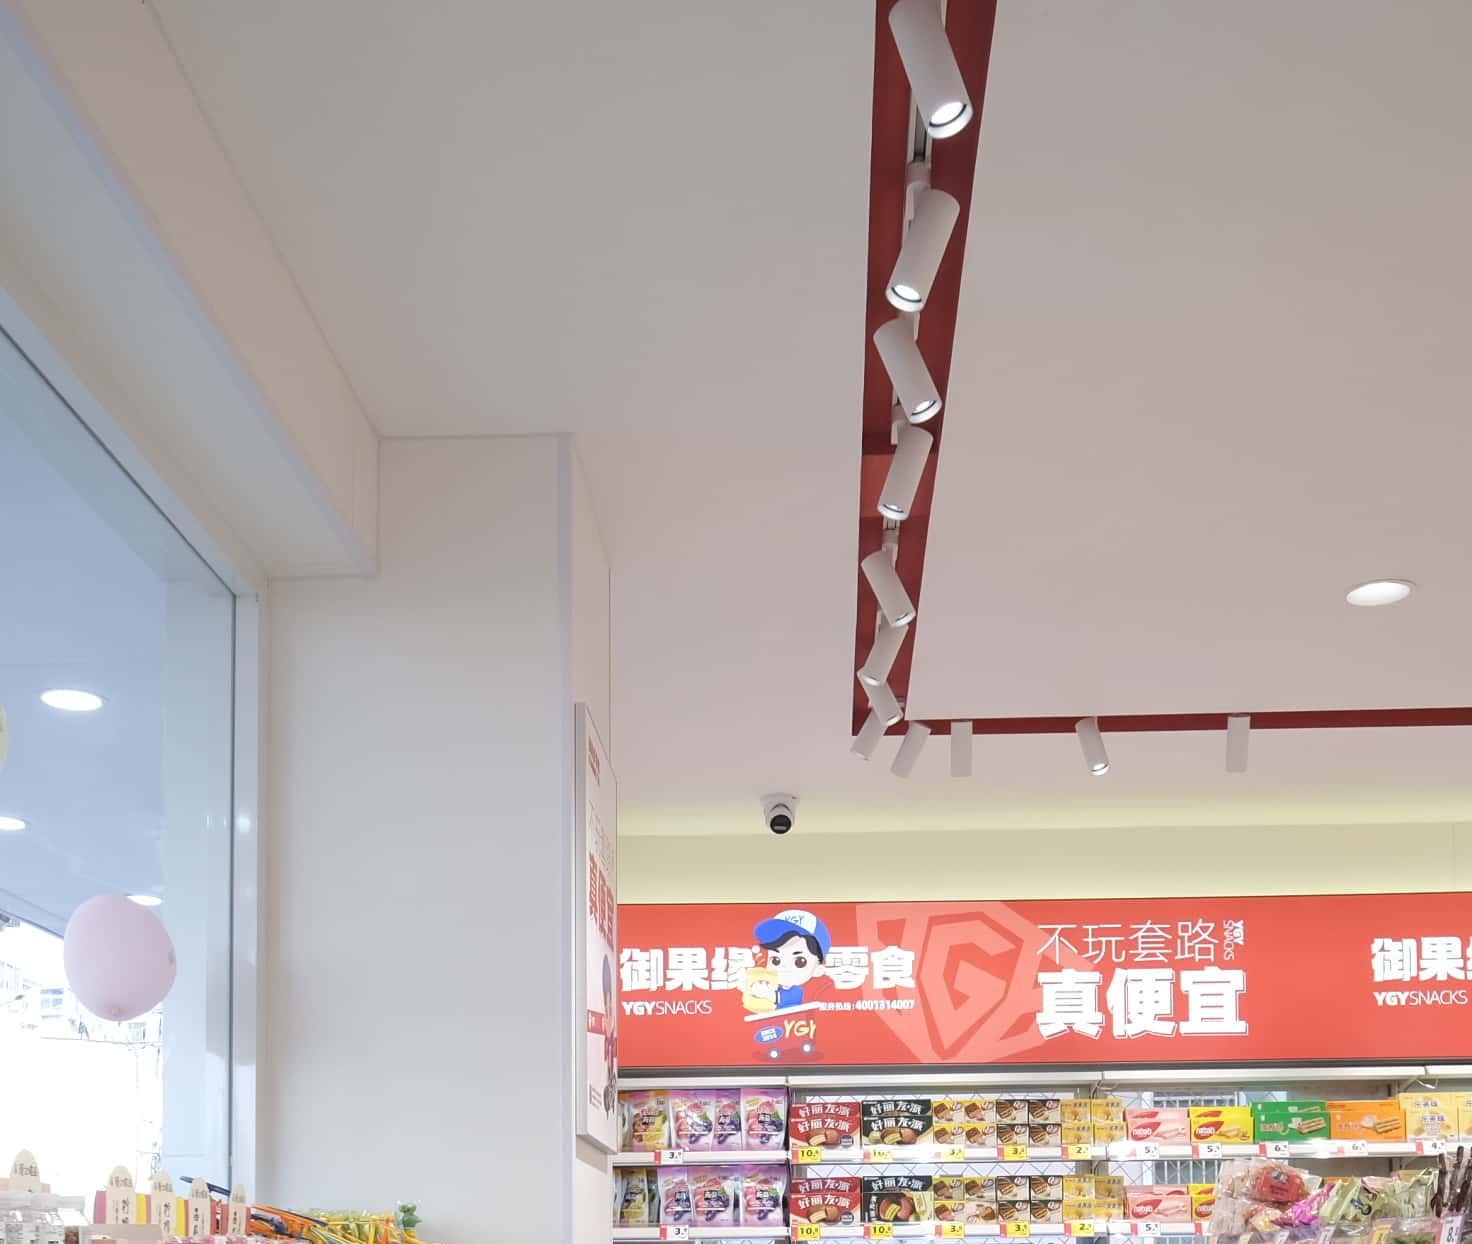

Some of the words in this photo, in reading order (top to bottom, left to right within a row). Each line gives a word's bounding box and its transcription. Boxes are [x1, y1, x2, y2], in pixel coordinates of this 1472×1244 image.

[1036, 918, 1219, 965] 不玩套路
[619, 947, 754, 991] 御果缘
[825, 945, 915, 990] 零食
[1035, 966, 1248, 1040] 真便宜
